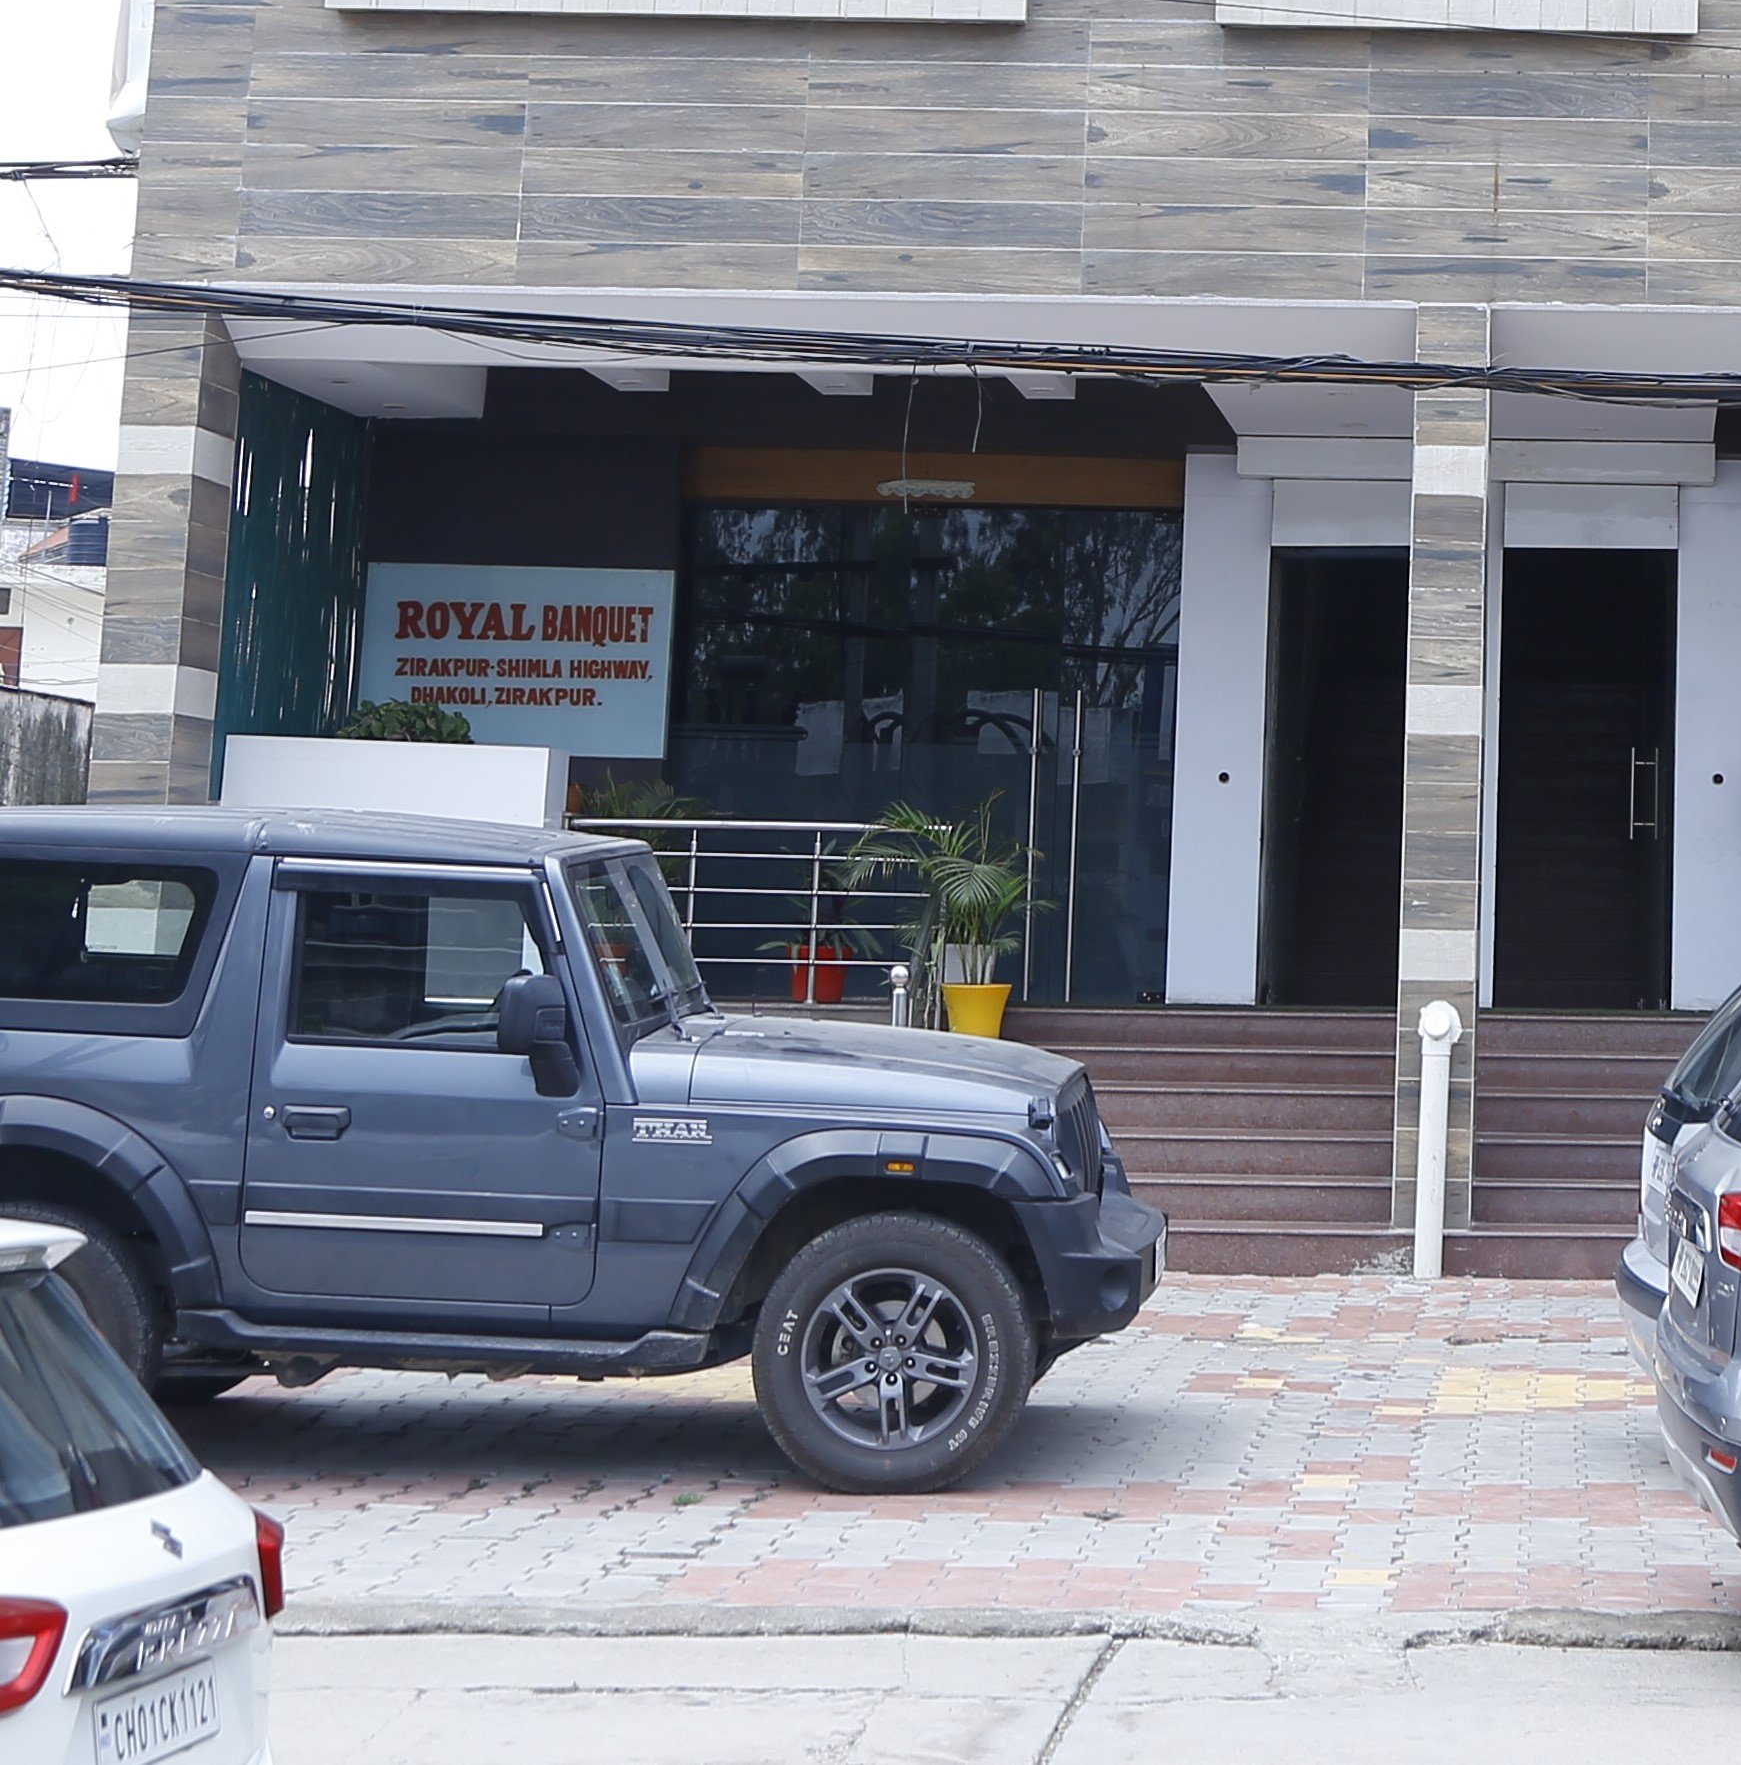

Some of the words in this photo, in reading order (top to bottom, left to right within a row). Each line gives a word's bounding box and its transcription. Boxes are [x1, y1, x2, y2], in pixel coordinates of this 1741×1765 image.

[394, 600, 536, 641] ROYAL
[541, 605, 655, 647] BANQUET
[569, 659, 654, 683] HIGHWAY,
[633, 1120, 712, 1142] THAR
[777, 1309, 799, 1356] CEAT
[114, 1676, 216, 1760] CH01CK1121
